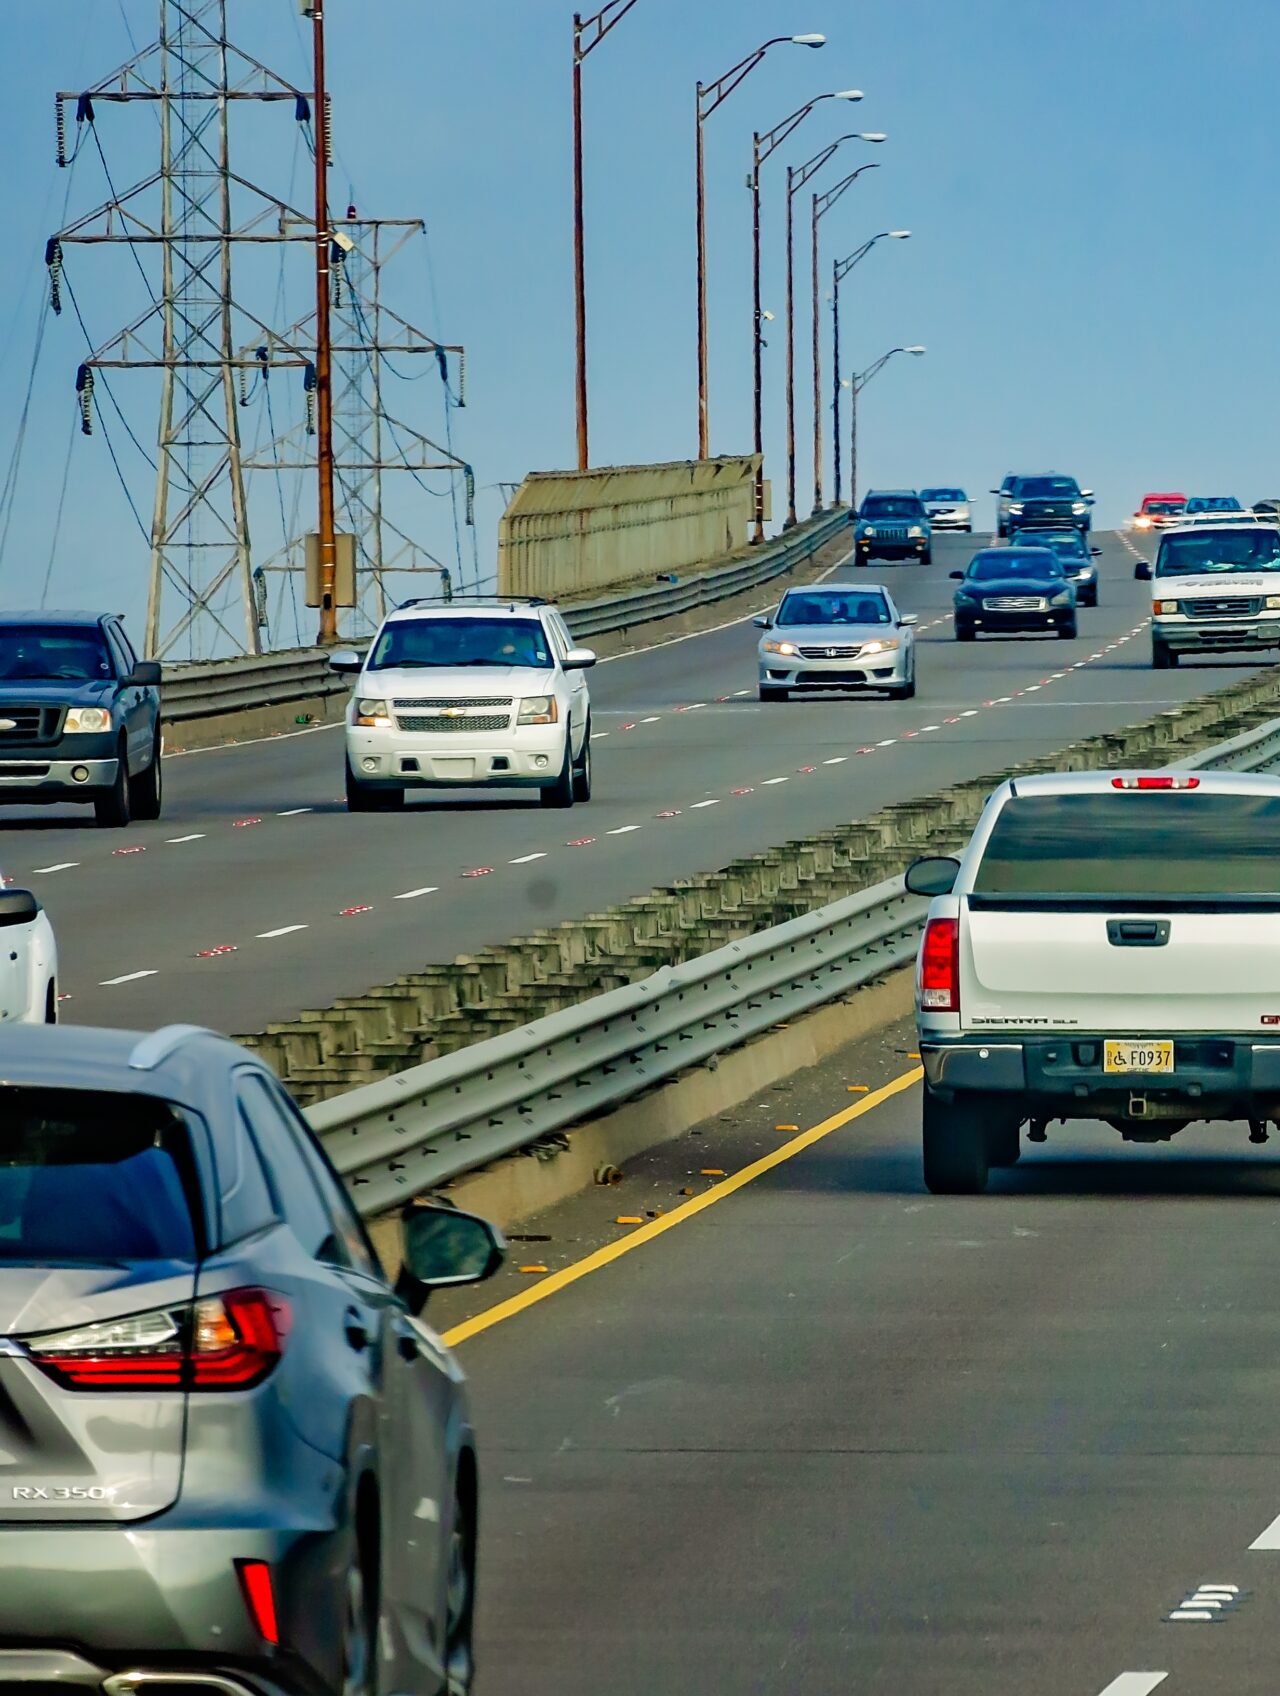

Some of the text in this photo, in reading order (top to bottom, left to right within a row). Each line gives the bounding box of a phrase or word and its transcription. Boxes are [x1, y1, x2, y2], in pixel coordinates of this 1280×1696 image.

[1130, 1050, 1171, 1066] F0937
[12, 1486, 106, 1499] RX 350
